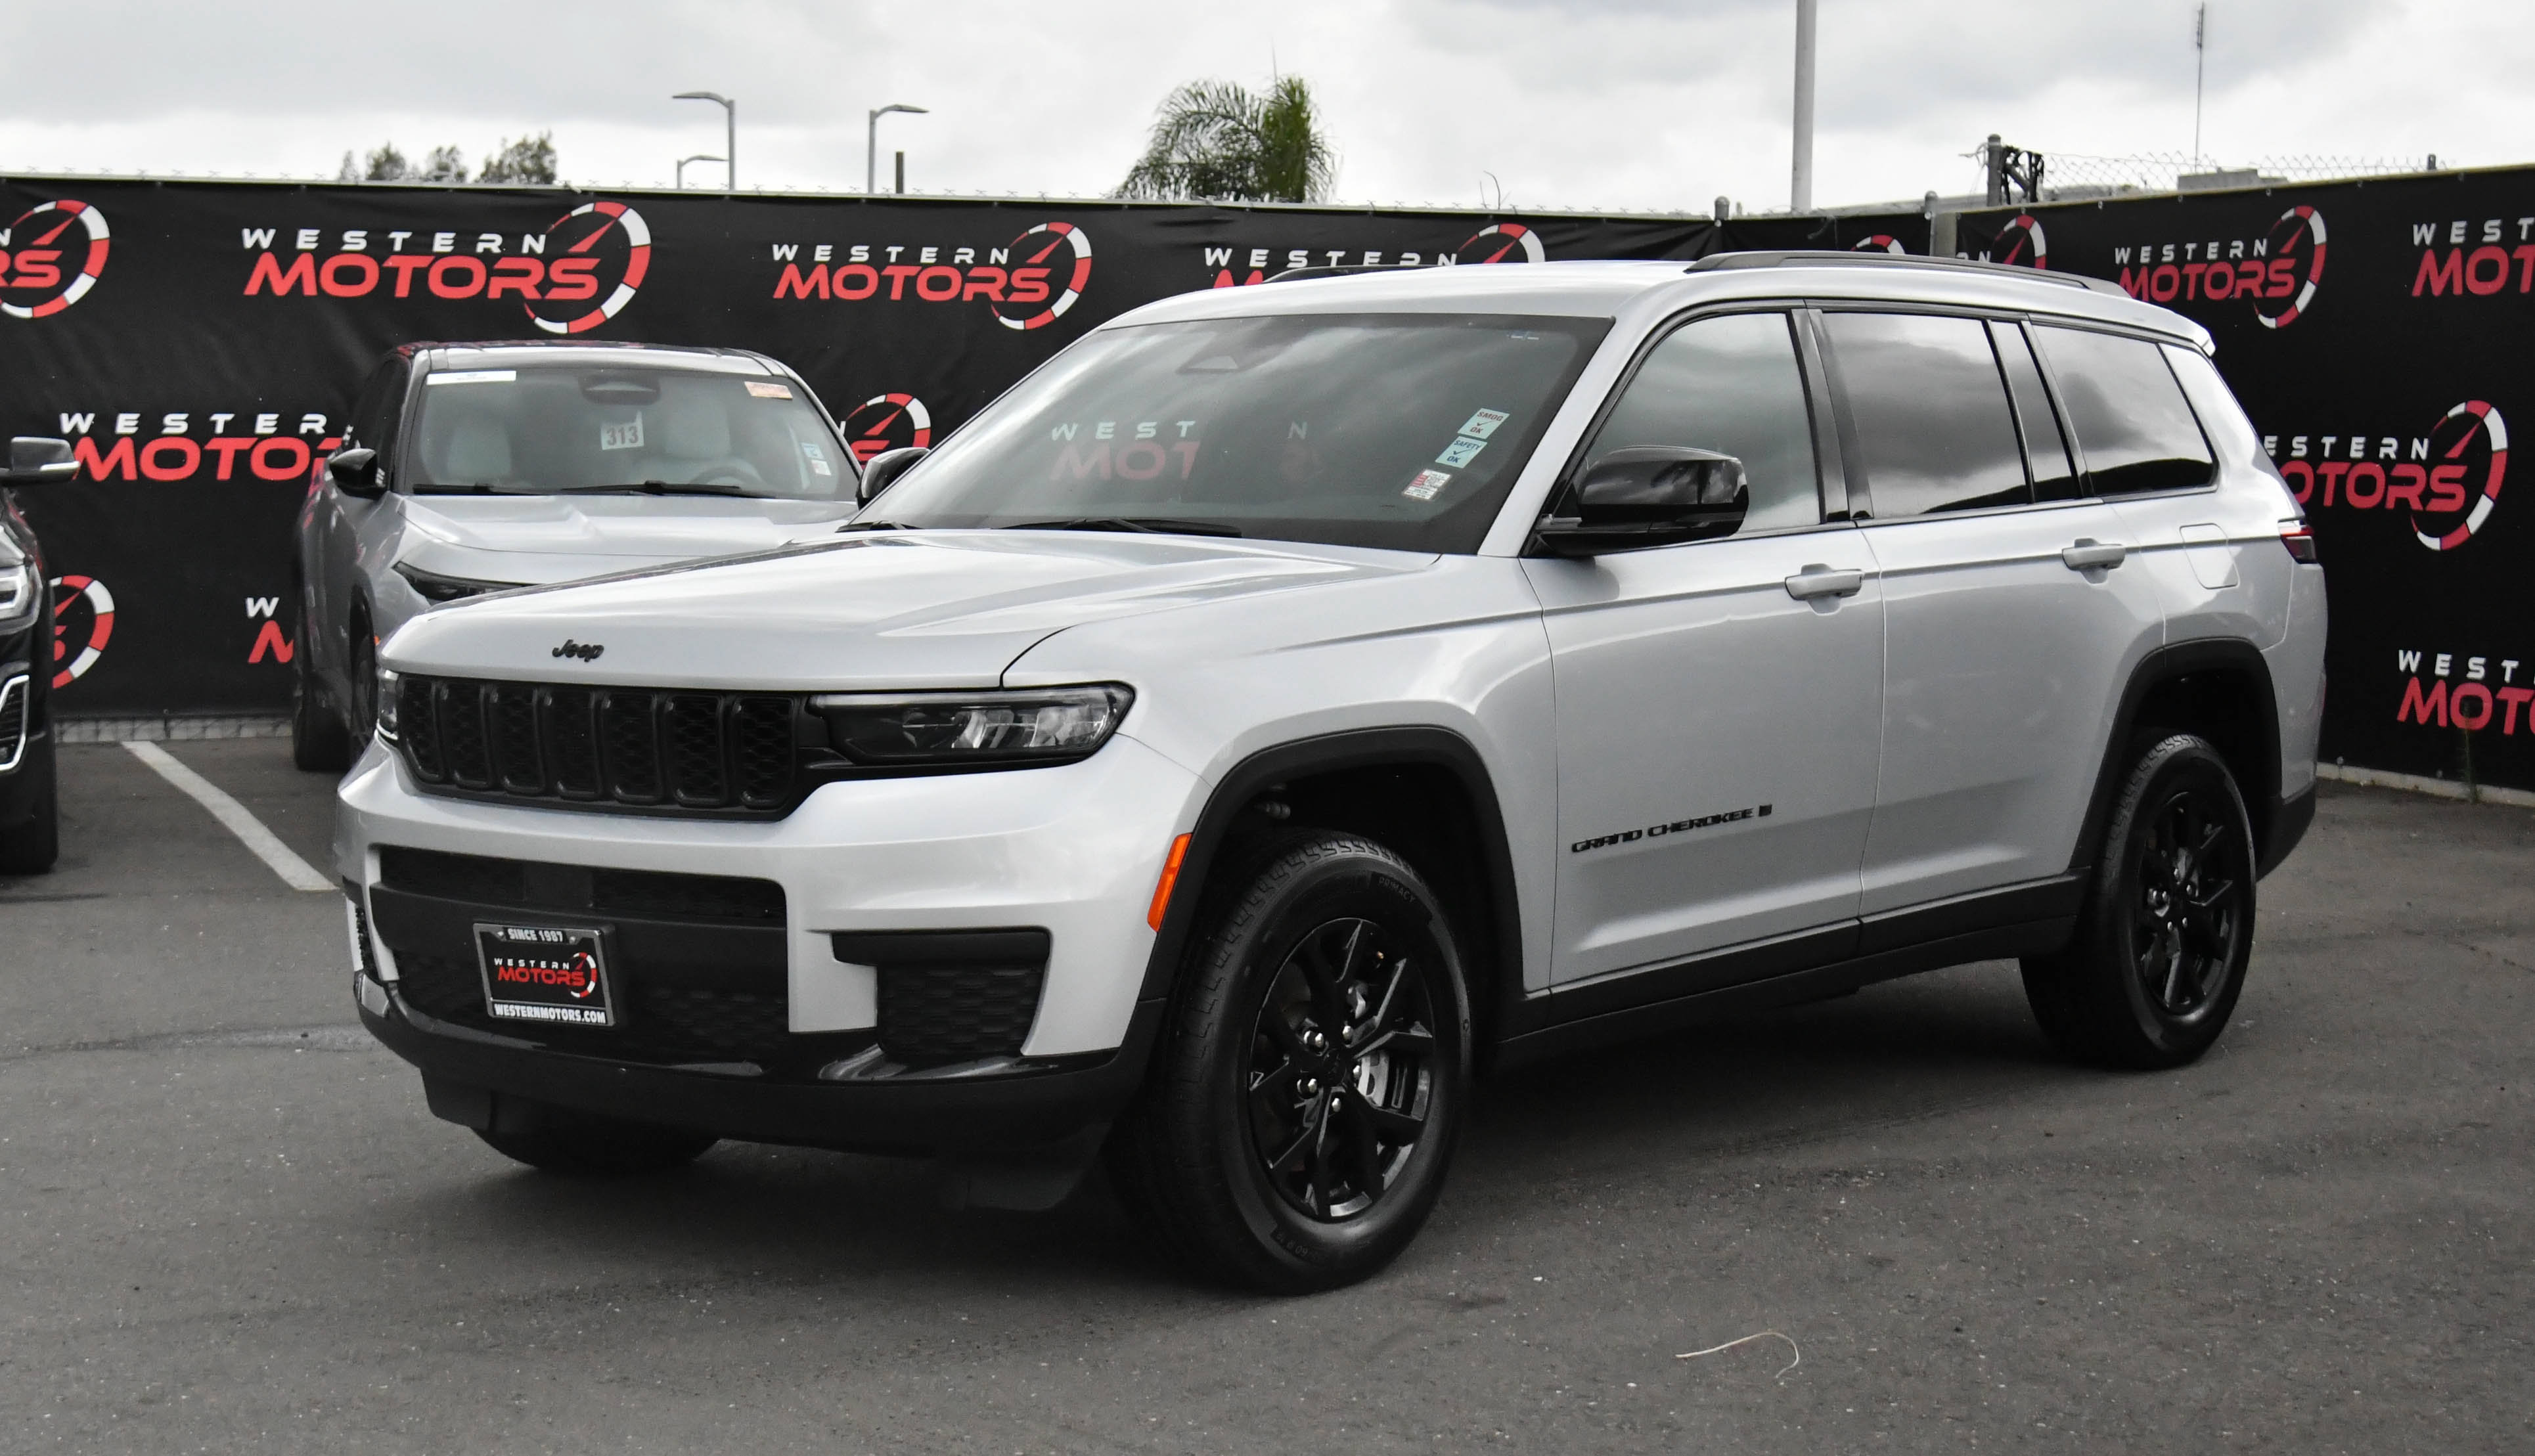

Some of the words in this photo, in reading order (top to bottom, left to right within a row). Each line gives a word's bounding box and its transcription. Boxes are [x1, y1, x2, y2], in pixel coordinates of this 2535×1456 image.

[242, 229, 547, 254] WESTERN
[2412, 217, 2535, 246] WEST
[772, 244, 1009, 265] WESTERN
[2115, 238, 2268, 264] WESTERN
[243, 252, 600, 299] MOTORS
[773, 263, 1051, 302] MOTORS
[2117, 258, 2296, 301] MOTORS
[2412, 244, 2535, 298] MOT
[59, 412, 327, 434] WESTER
[1476, 411, 1504, 421] SMOG
[606, 426, 639, 446] 313
[1454, 440, 1482, 450] SAFETY
[2263, 435, 2429, 460] ESTERN
[1447, 455, 1461, 464] OK
[2279, 460, 2467, 512] OTORS
[552, 639, 604, 663] Jeep
[2398, 650, 2520, 684] WEST
[1571, 829, 1642, 853] GRAND
[1648, 808, 1755, 838] CHEROKEE
[507, 928, 537, 940] SINCE
[539, 929, 563, 942] 1987
[494, 958, 570, 970] WESTERN
[497, 966, 585, 987] MOTORS
[494, 1004, 606, 1025] WESTERNMOTORS.COM
